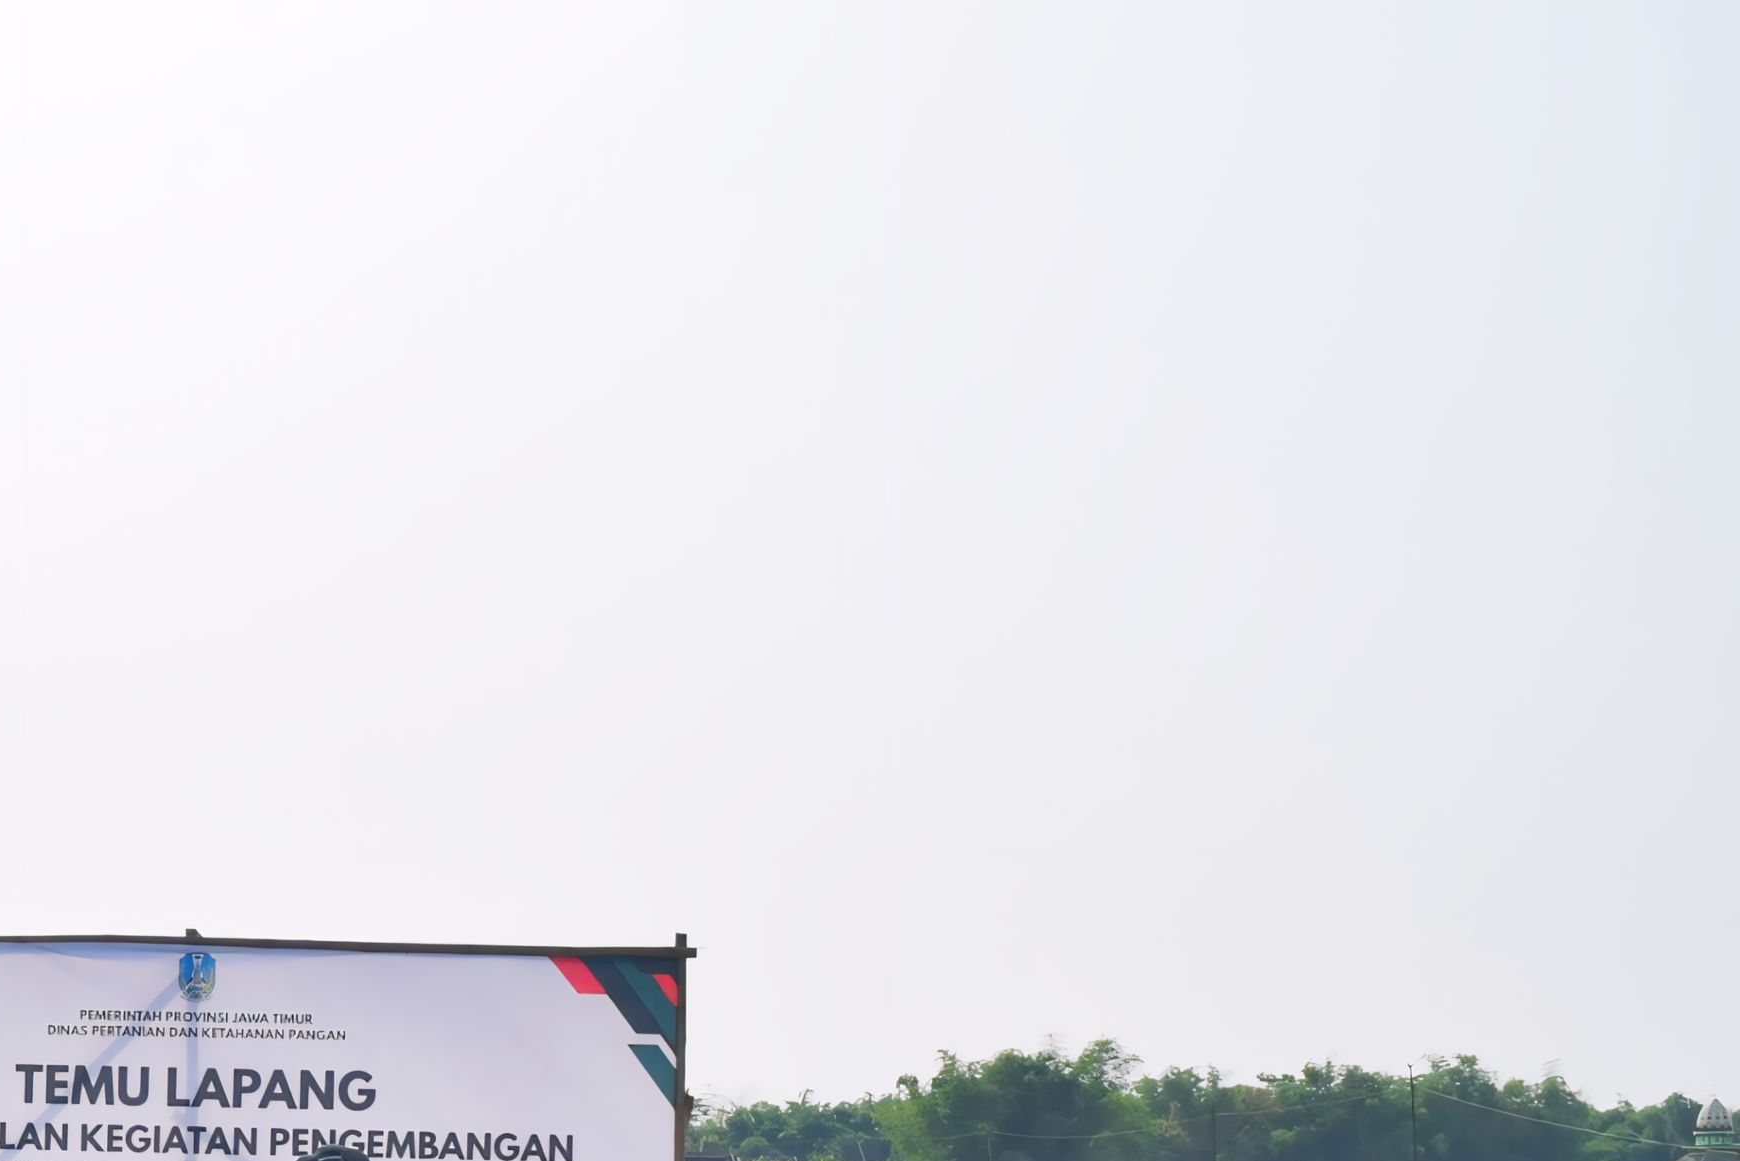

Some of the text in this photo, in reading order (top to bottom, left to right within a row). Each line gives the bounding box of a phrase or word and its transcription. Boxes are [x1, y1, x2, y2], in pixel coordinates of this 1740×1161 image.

[79, 1009, 313, 1025] PEMERINTAH PROVINSI JAWA TIMUR
[47, 1024, 347, 1041] DINAS PERTANIAN DAN KETAHANAN PANGAN
[15, 1063, 377, 1112] TEMU LAPANG
[80, 1123, 258, 1156] KEGIATAN
